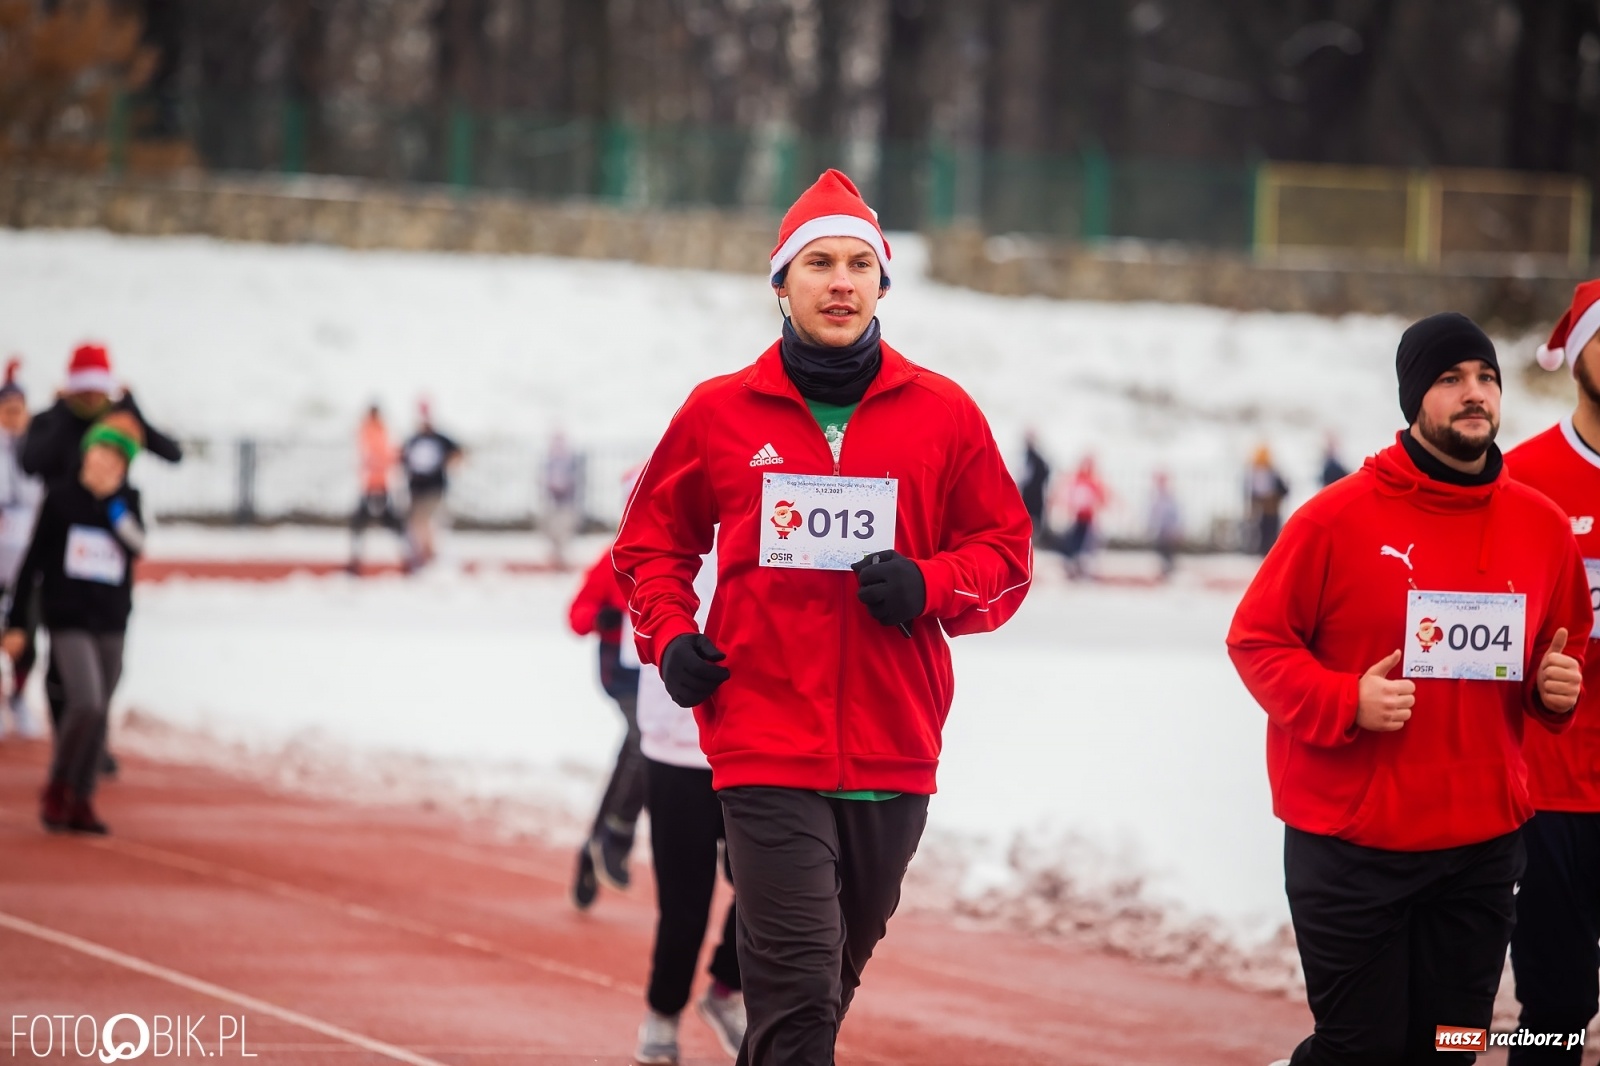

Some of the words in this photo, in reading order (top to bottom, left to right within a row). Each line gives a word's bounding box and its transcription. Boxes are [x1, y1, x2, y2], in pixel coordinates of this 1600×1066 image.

[749, 456, 784, 467] adidas
[807, 508, 875, 539] 013
[1448, 624, 1512, 651] 004
